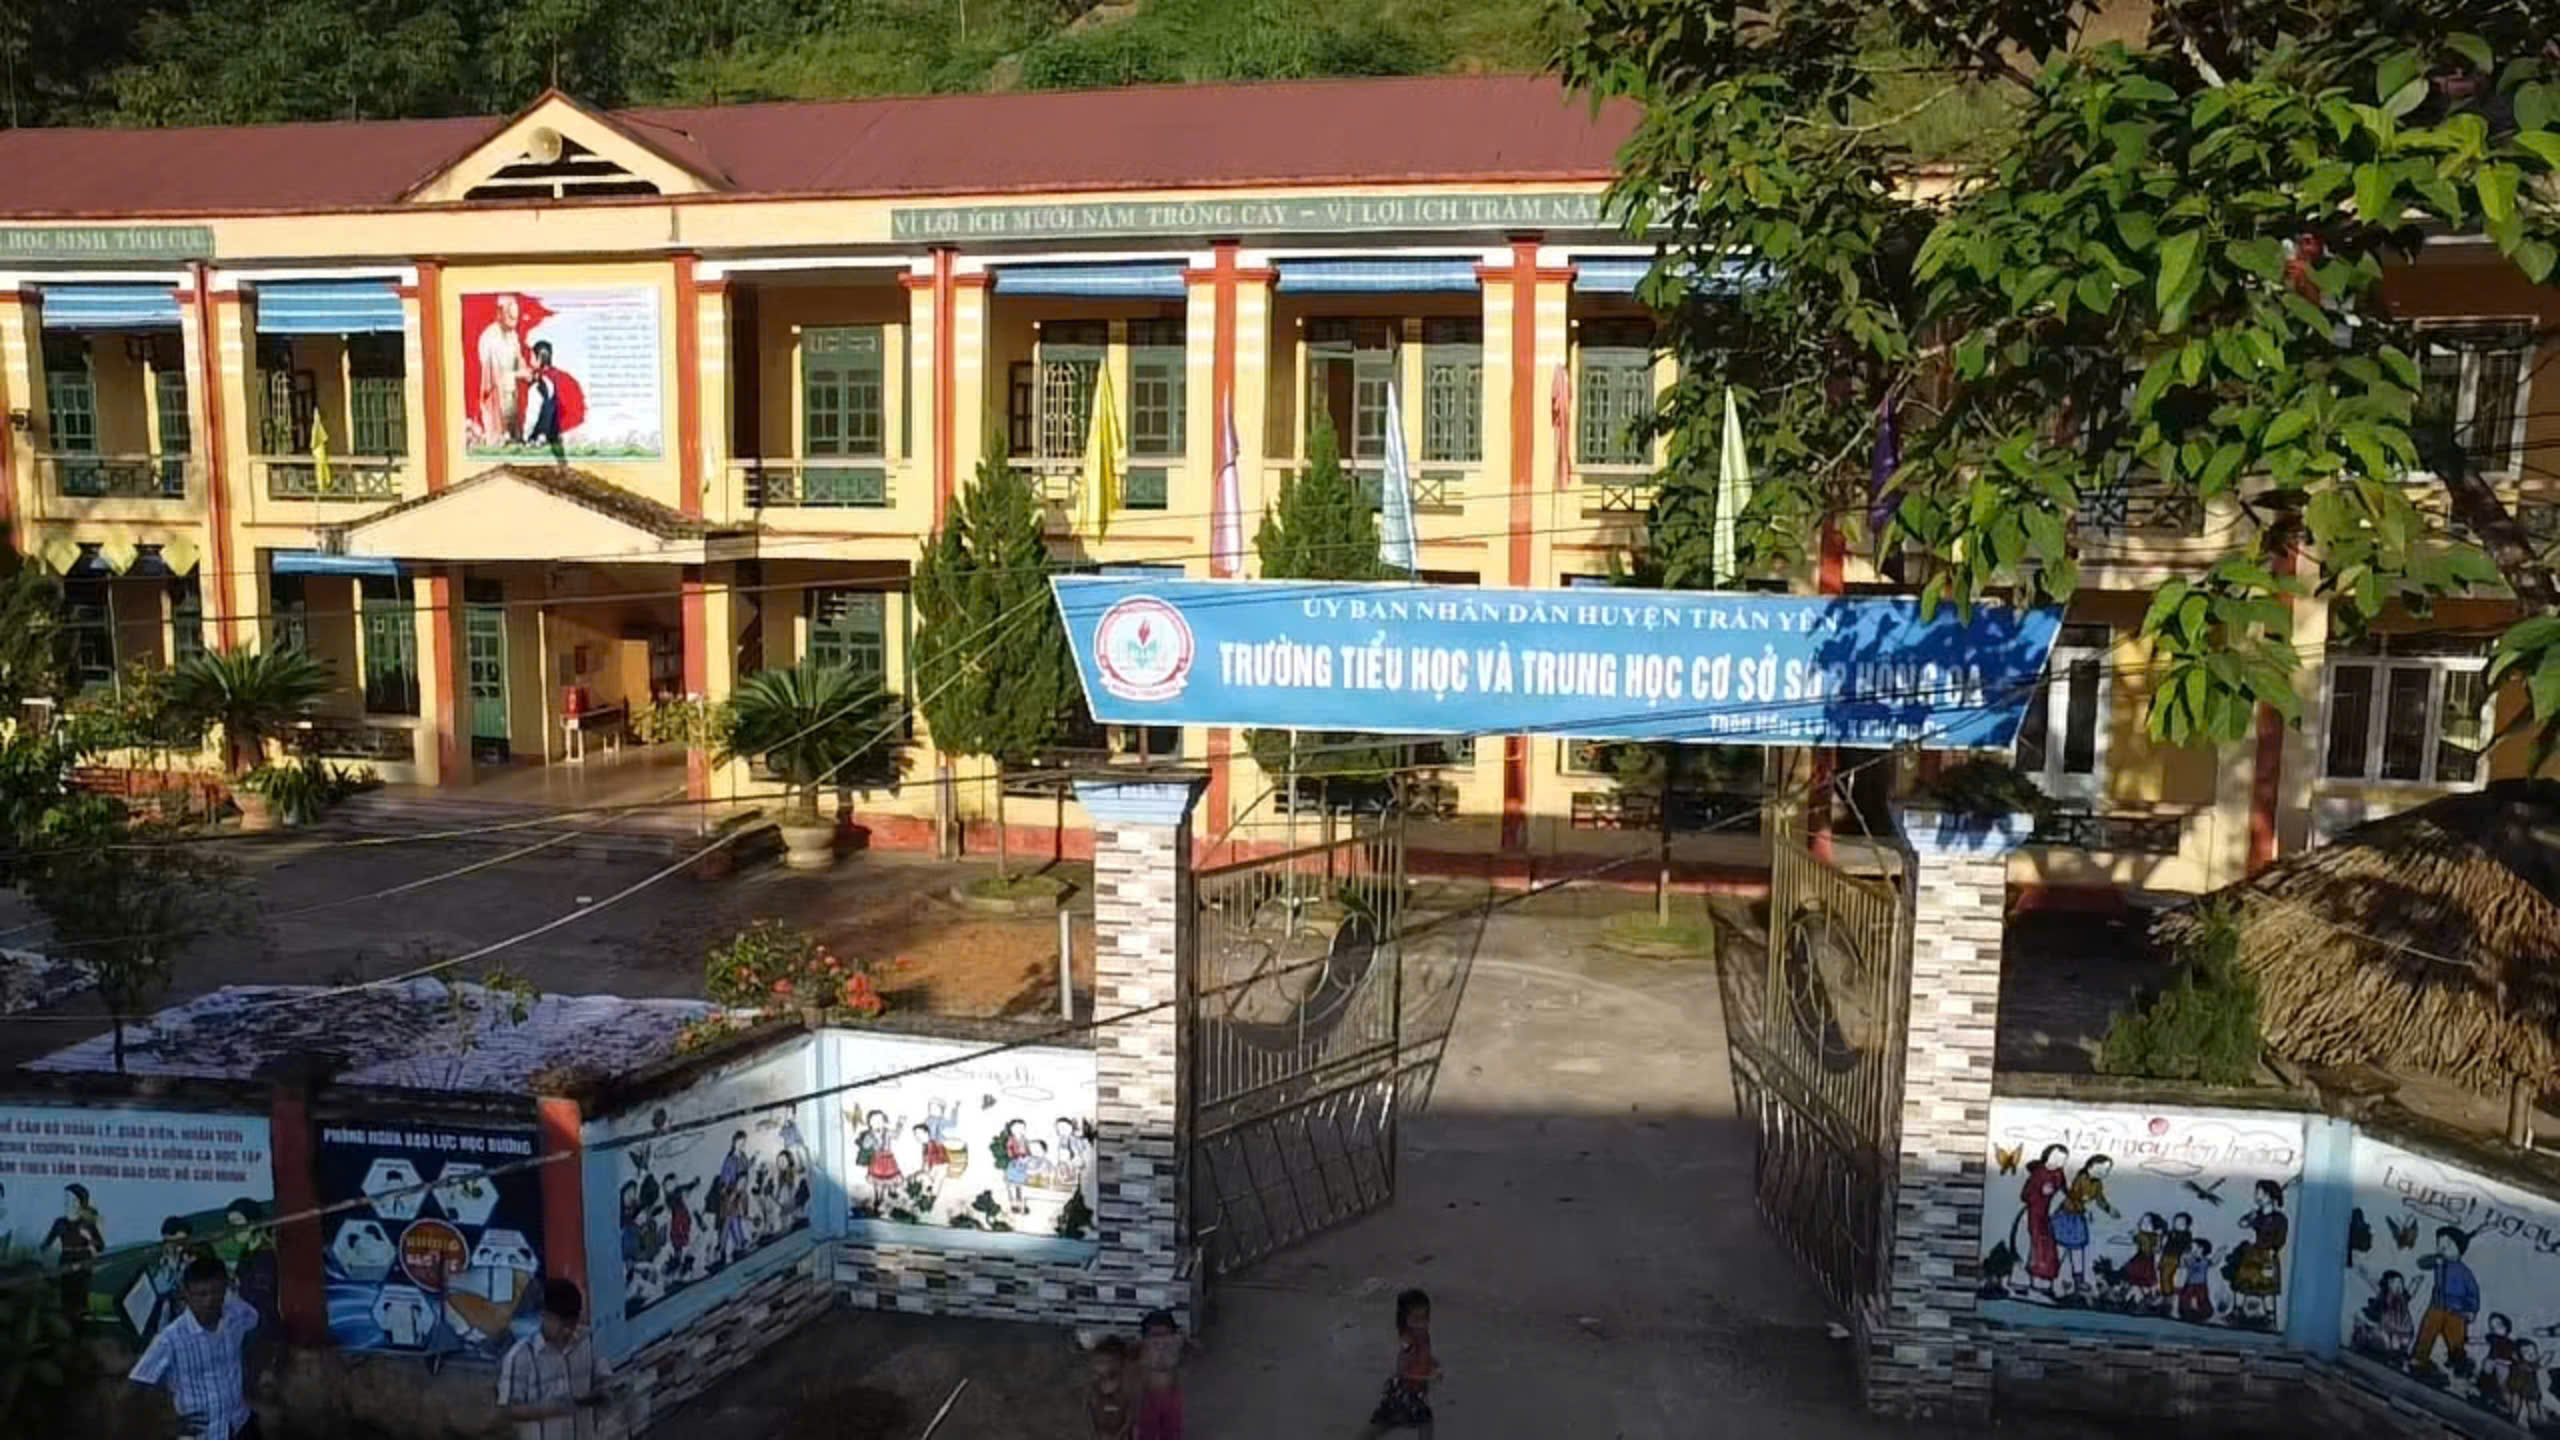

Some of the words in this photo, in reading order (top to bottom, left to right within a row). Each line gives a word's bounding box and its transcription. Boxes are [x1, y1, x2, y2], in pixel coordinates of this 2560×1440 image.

[1350, 598, 1409, 621] BAN
[1416, 596, 1500, 623] NHÂN
[1577, 604, 1682, 631] HUYỆN
[1219, 633, 1332, 690] TRƯỜNG
[1340, 628, 1399, 691] TIỂU
[1410, 645, 1470, 702] HỌC
[1479, 641, 1514, 696] VÀ
[1522, 650, 1618, 698] TRUNG
[1625, 653, 1683, 709] HỌC
[1691, 653, 1732, 701] CƠ
[1737, 642, 1780, 702] SỞ
